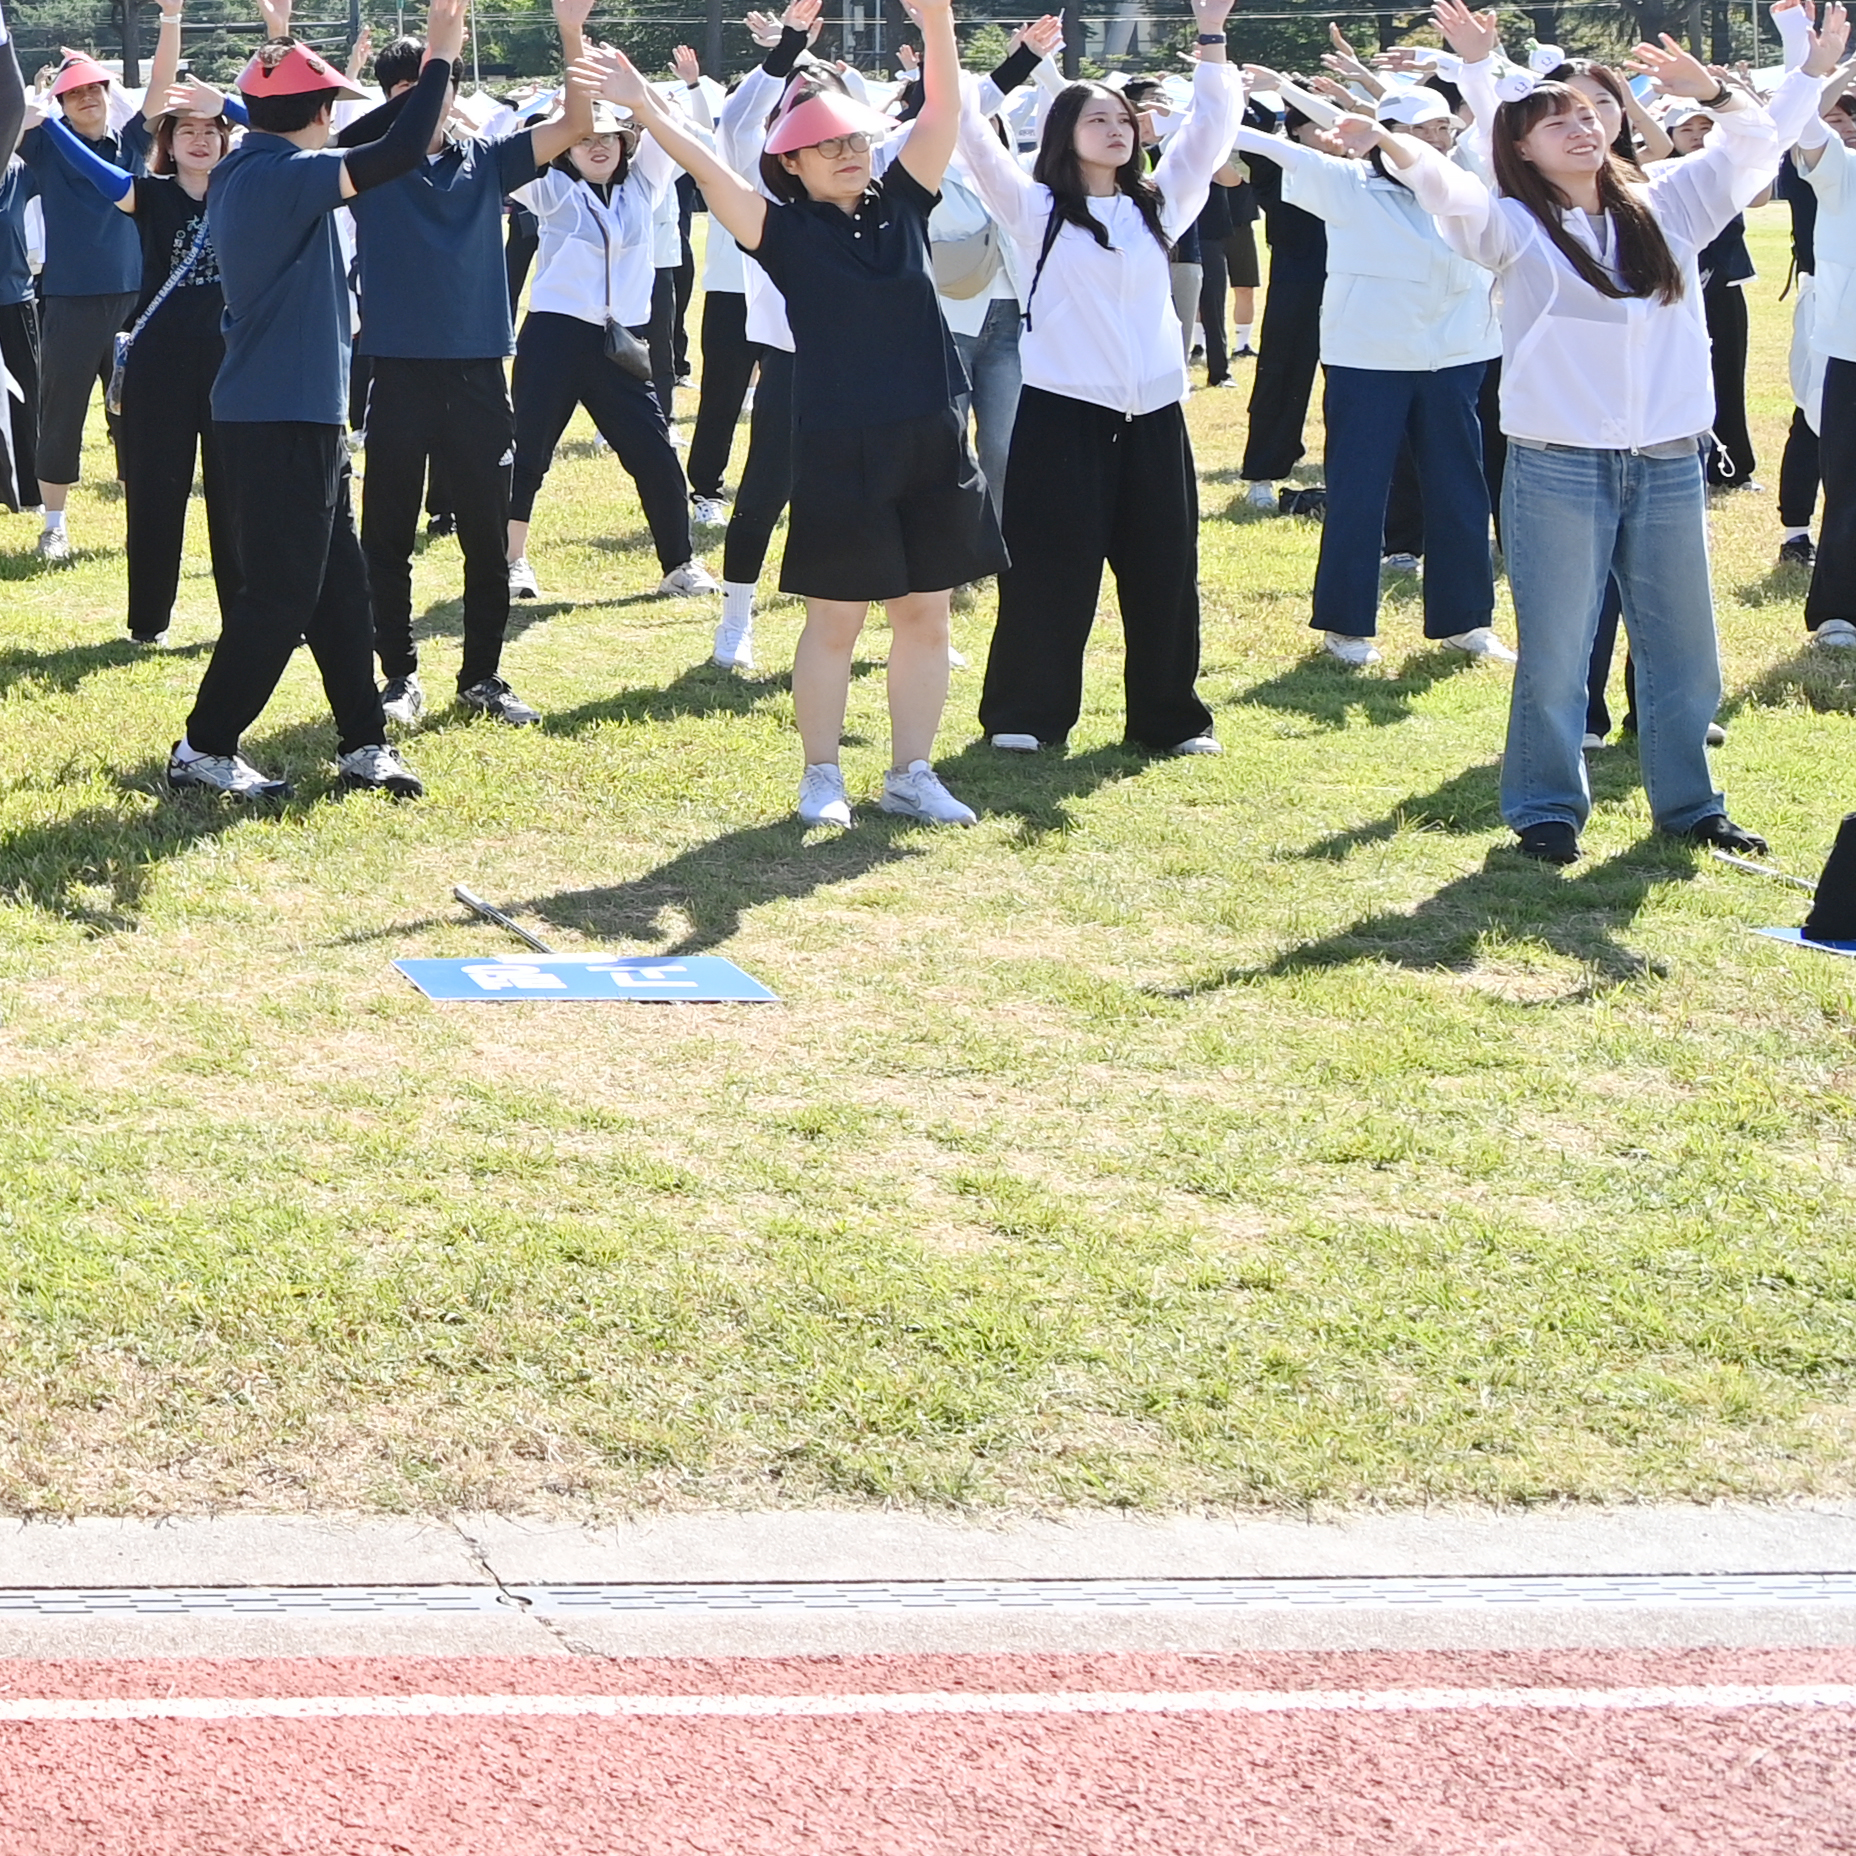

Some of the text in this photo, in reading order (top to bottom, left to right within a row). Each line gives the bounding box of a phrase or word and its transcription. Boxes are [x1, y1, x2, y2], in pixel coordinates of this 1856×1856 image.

[144, 247, 199, 316] LIONS BASEBALL CLUB
[461, 964, 698, 991] 고령
